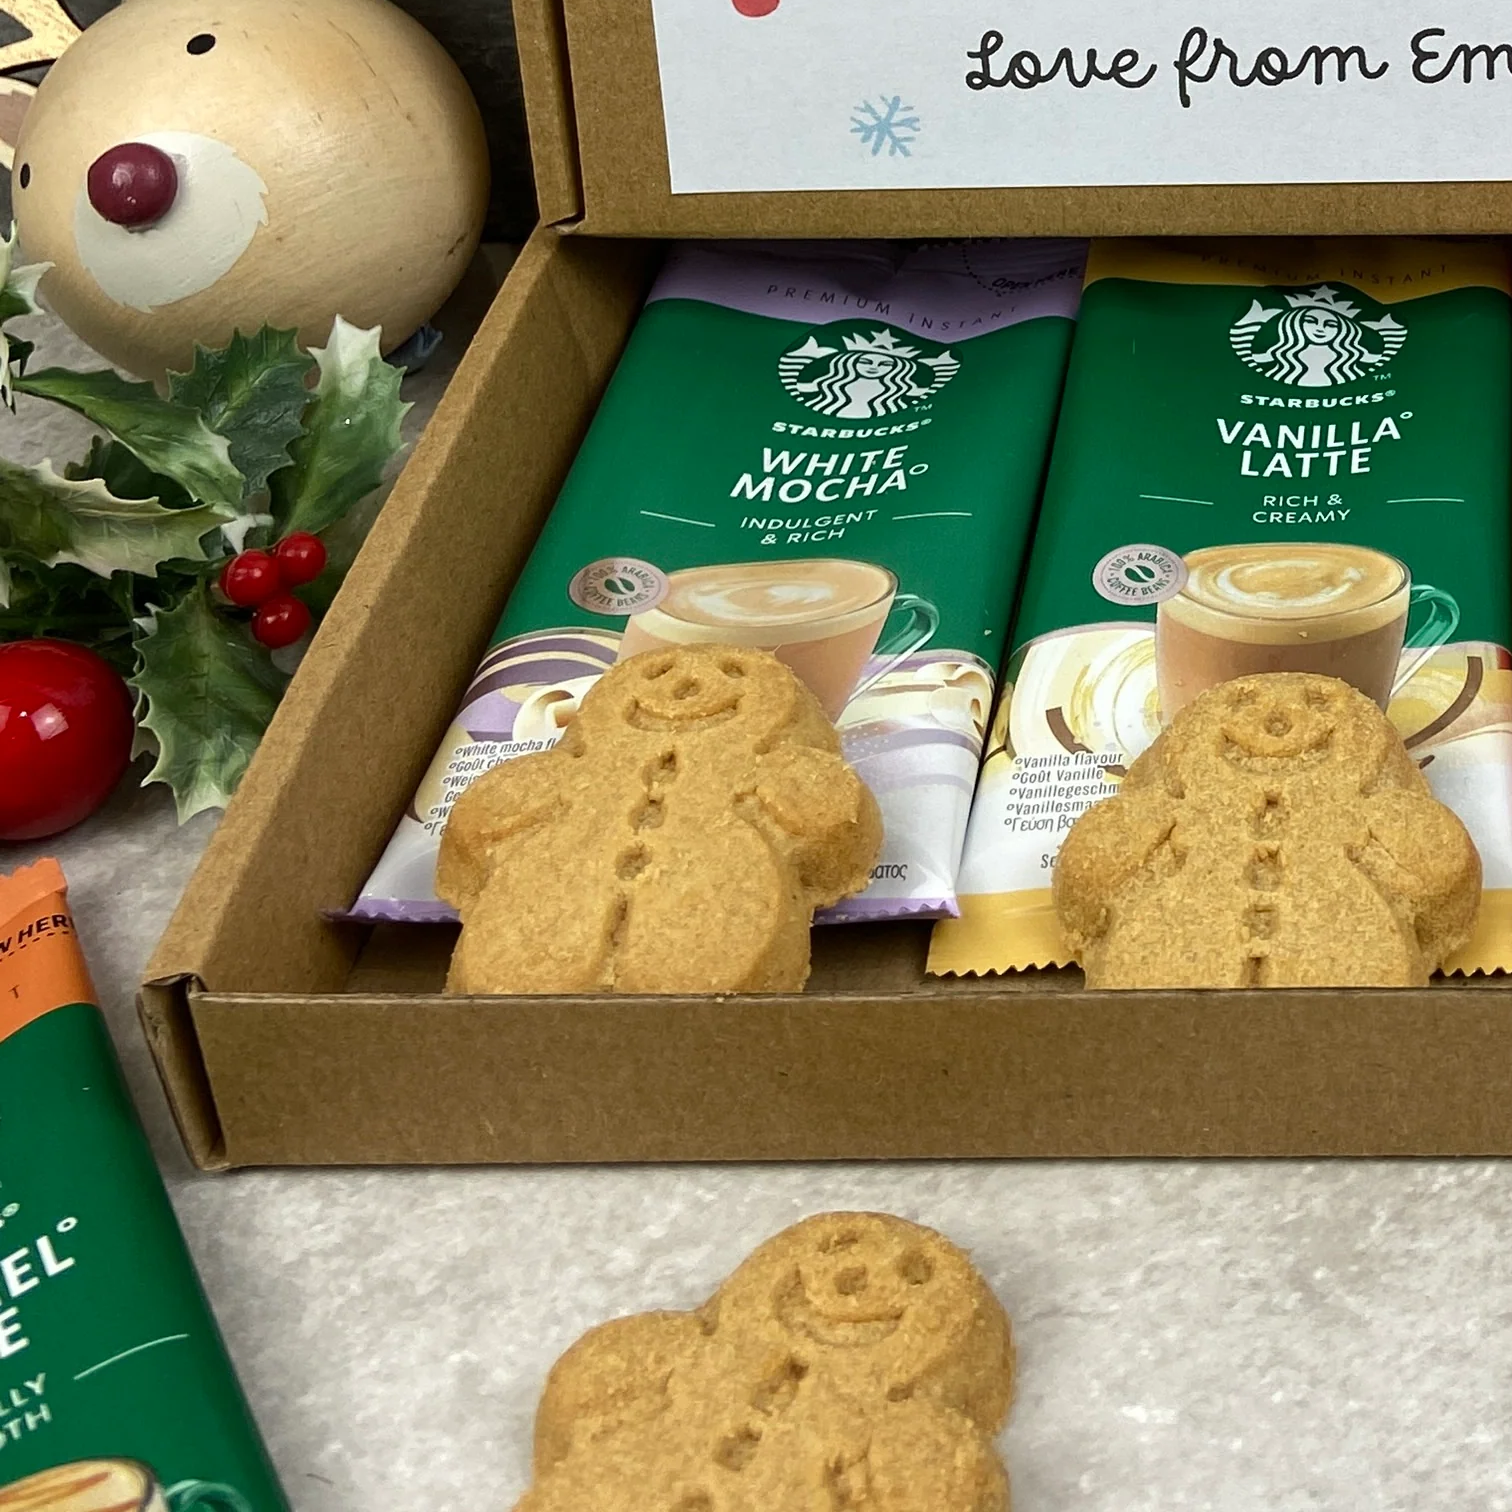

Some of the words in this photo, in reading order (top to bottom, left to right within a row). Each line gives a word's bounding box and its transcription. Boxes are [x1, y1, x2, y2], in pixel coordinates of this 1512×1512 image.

[965, 29, 1157, 90] Love
[1174, 26, 1388, 108] from
[1340, 263, 1449, 286] INSTANT
[767, 283, 892, 315] PREMIUM
[763, 444, 909, 477] WHITE
[1240, 447, 1372, 478] LATTE
[1263, 494, 1319, 507] RICH
[1327, 493, 1343, 506] &
[739, 509, 879, 530] INDULGENT
[1252, 508, 1351, 524] CREAMY
[760, 533, 778, 545] &
[786, 528, 846, 544] RICH
[499, 739, 542, 754] mocha
[1074, 752, 1124, 766] flavour
[1056, 767, 1104, 782] Vanille
